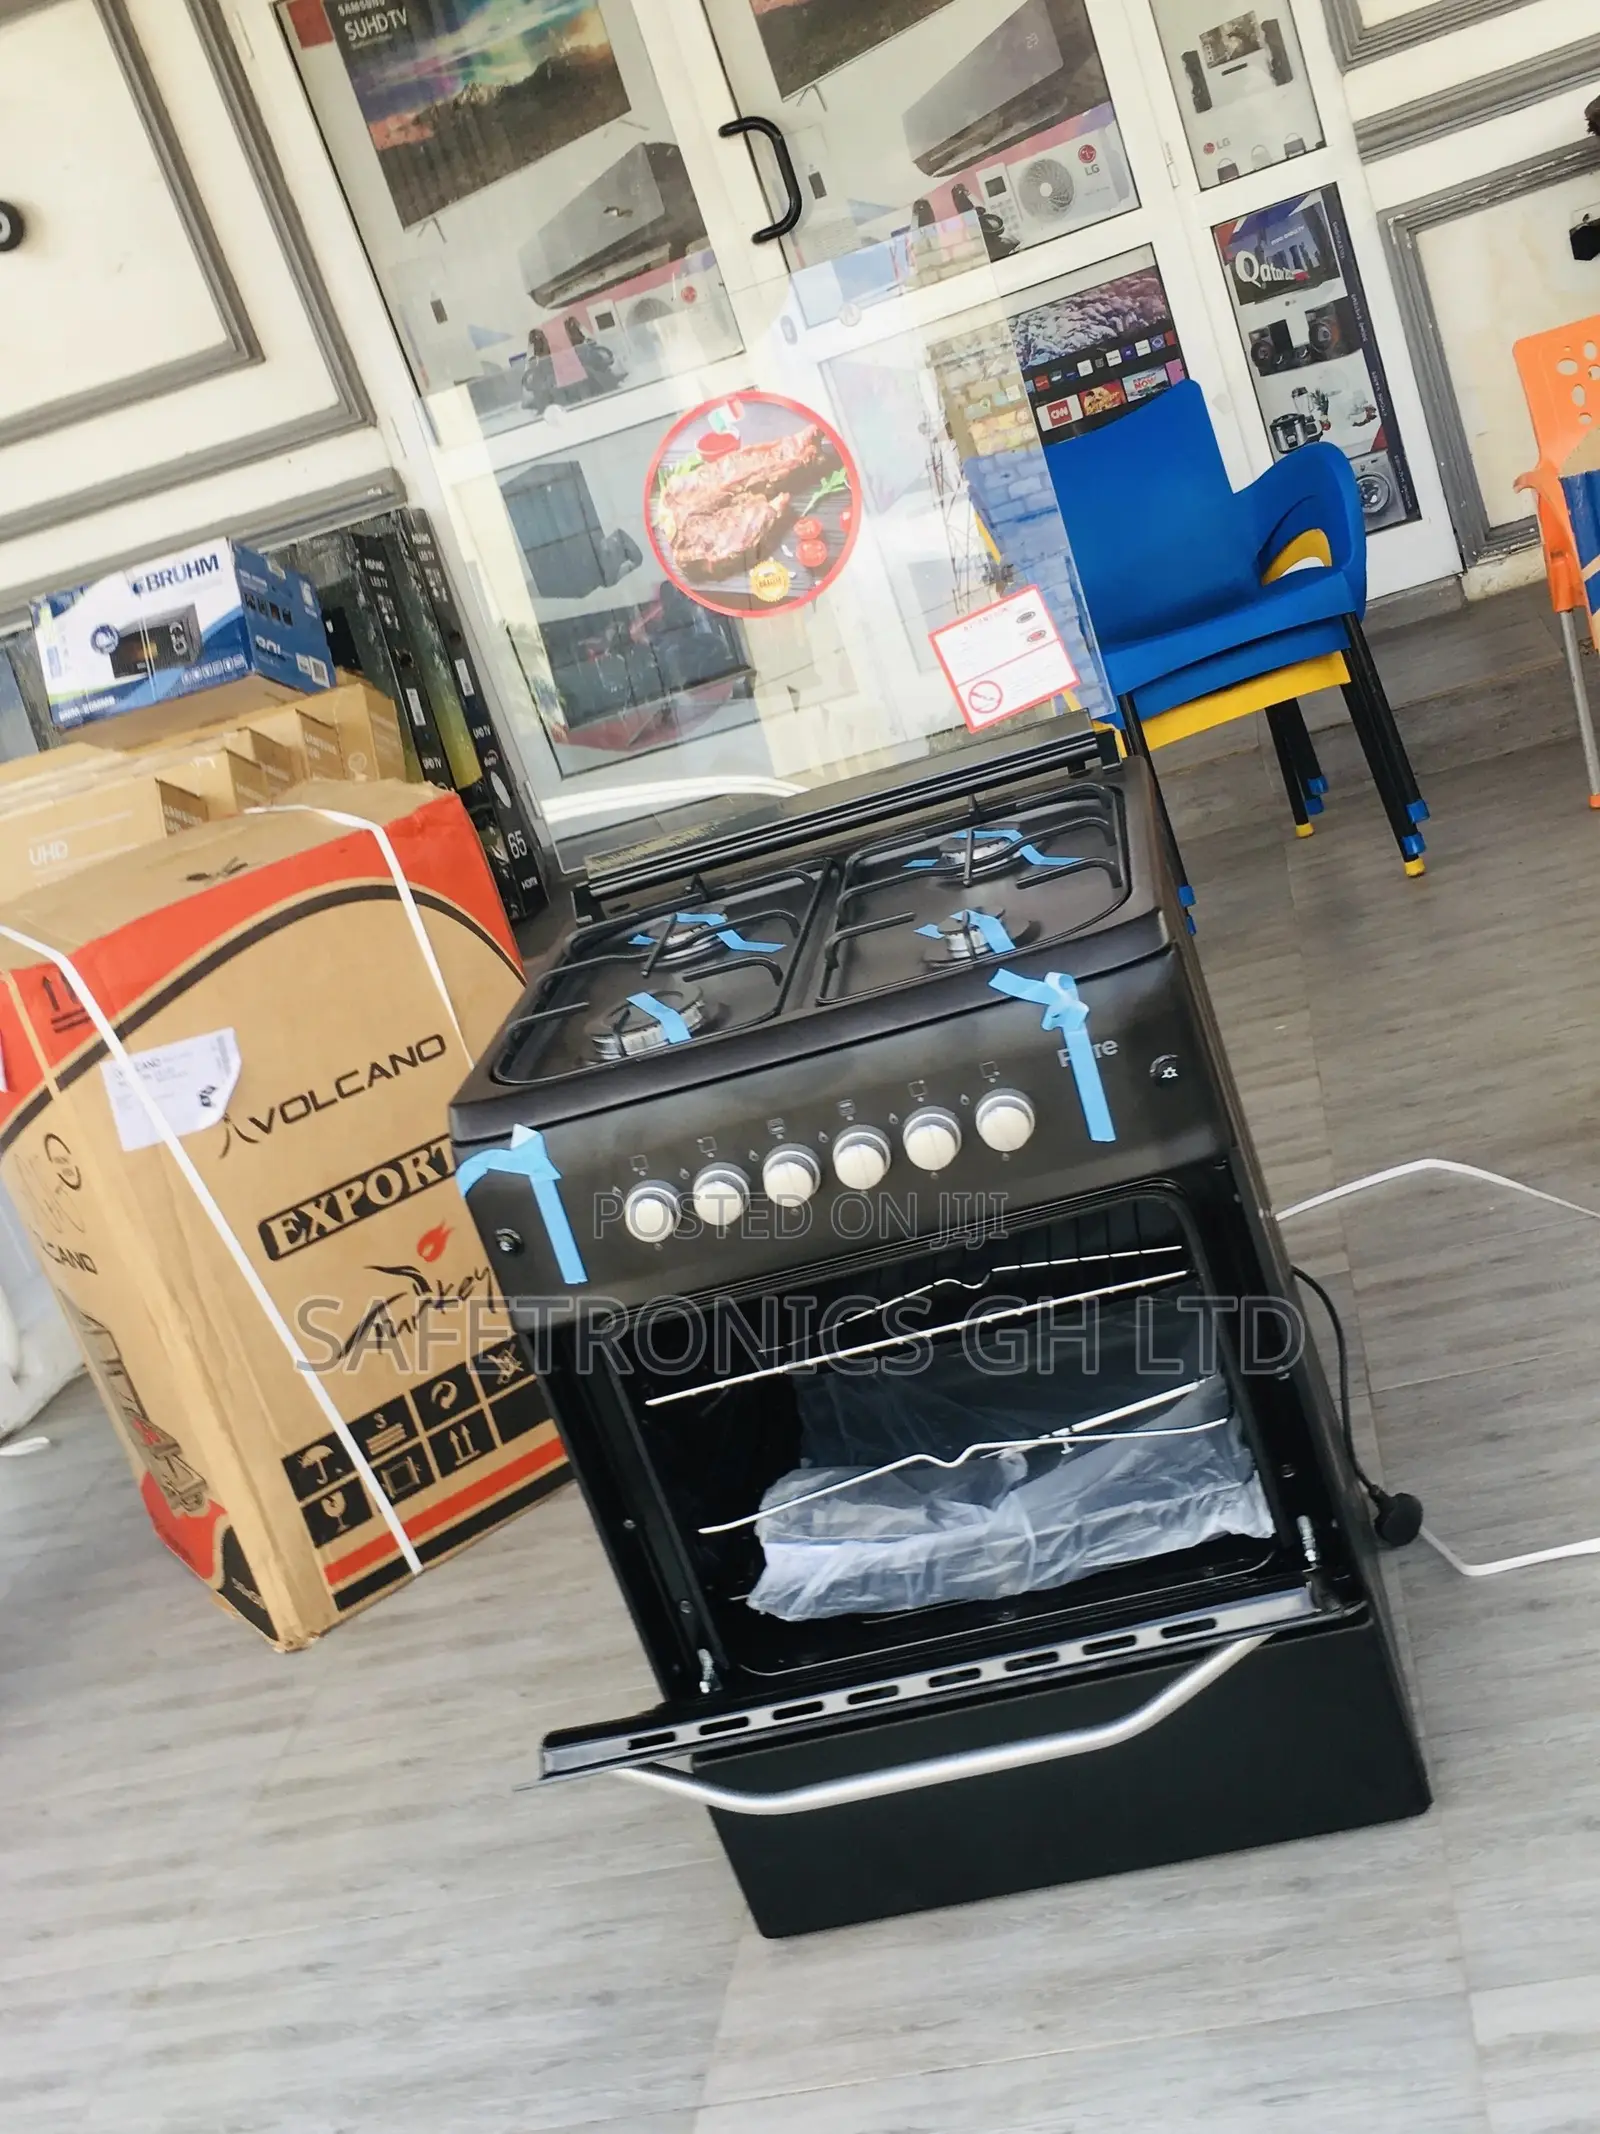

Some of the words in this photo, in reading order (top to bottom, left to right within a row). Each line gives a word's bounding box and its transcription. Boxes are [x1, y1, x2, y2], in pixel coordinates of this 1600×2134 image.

[1216, 138, 1231, 151] LG
[1084, 163, 1100, 176] LG
[1050, 407, 1069, 420] CNN
[507, 830, 528, 859] 65
[28, 840, 69, 866] UHD
[521, 876, 538, 890] HDMI
[248, 1033, 448, 1135] VOLCANO
